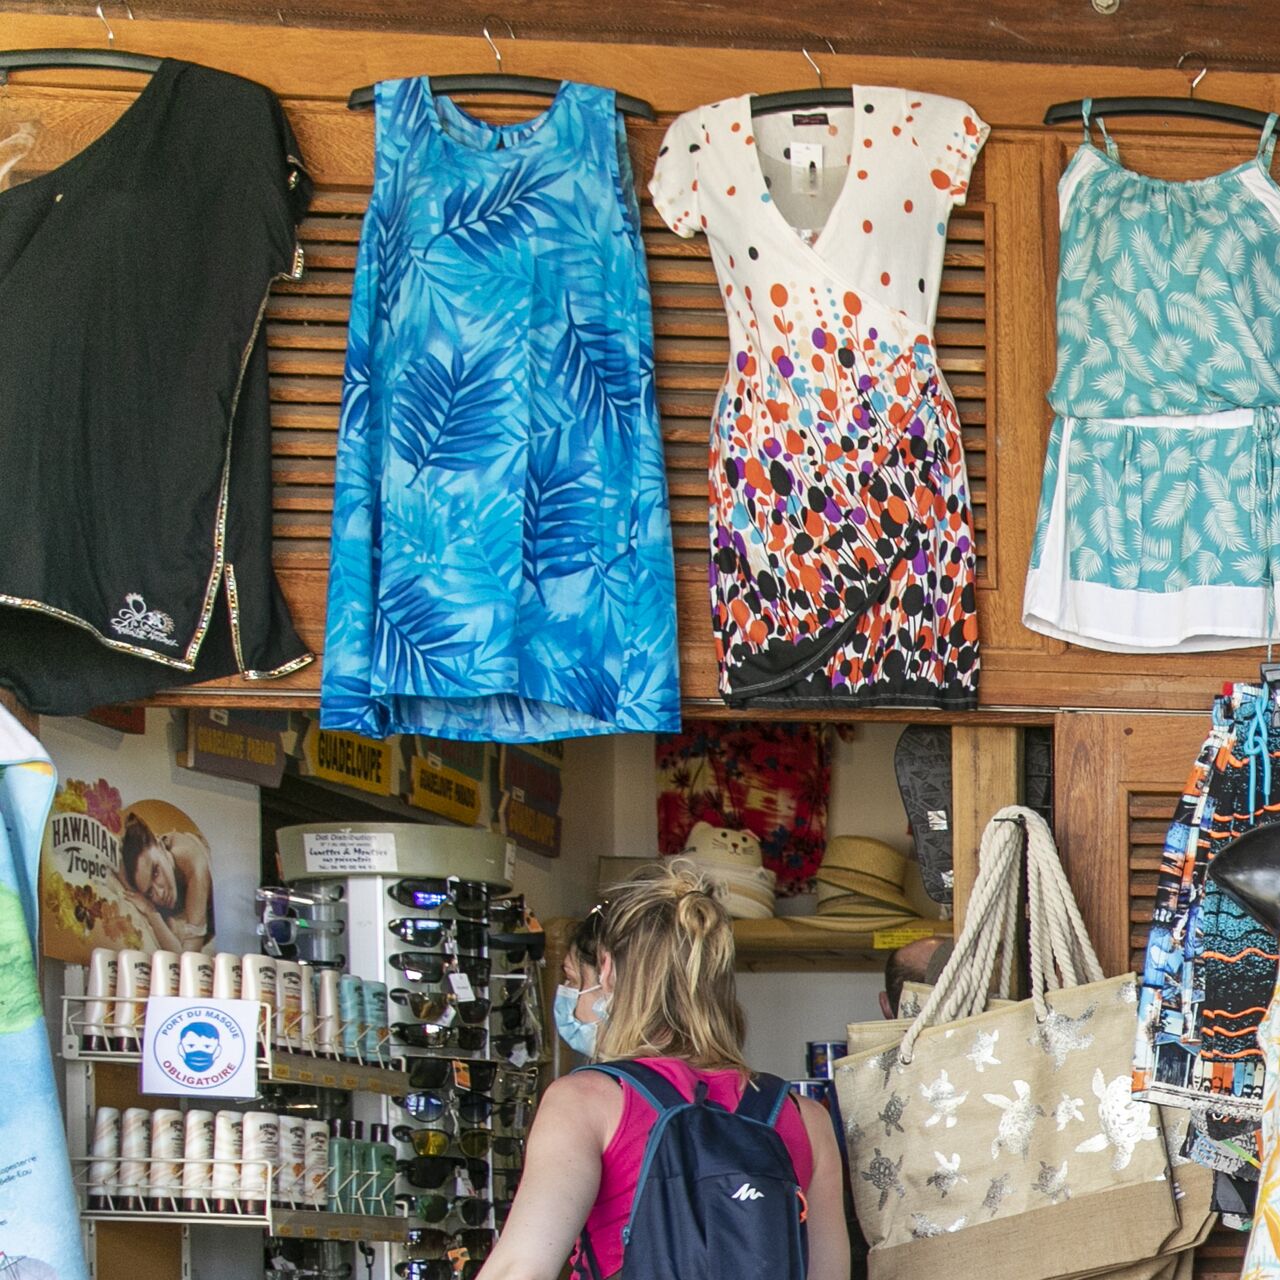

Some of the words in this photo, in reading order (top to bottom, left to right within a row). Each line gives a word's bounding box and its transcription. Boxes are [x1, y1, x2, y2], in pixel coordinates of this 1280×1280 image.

[318, 731, 382, 784] GUADELOUPE
[52, 817, 117, 867] HAWAIIAN
[64, 847, 106, 879] Tropic
[161, 1014, 183, 1036] PORT
[186, 1010, 202, 1018] DU
[205, 1010, 240, 1039] MASQUE
[162, 1060, 236, 1086] OBLIGATOIRE
